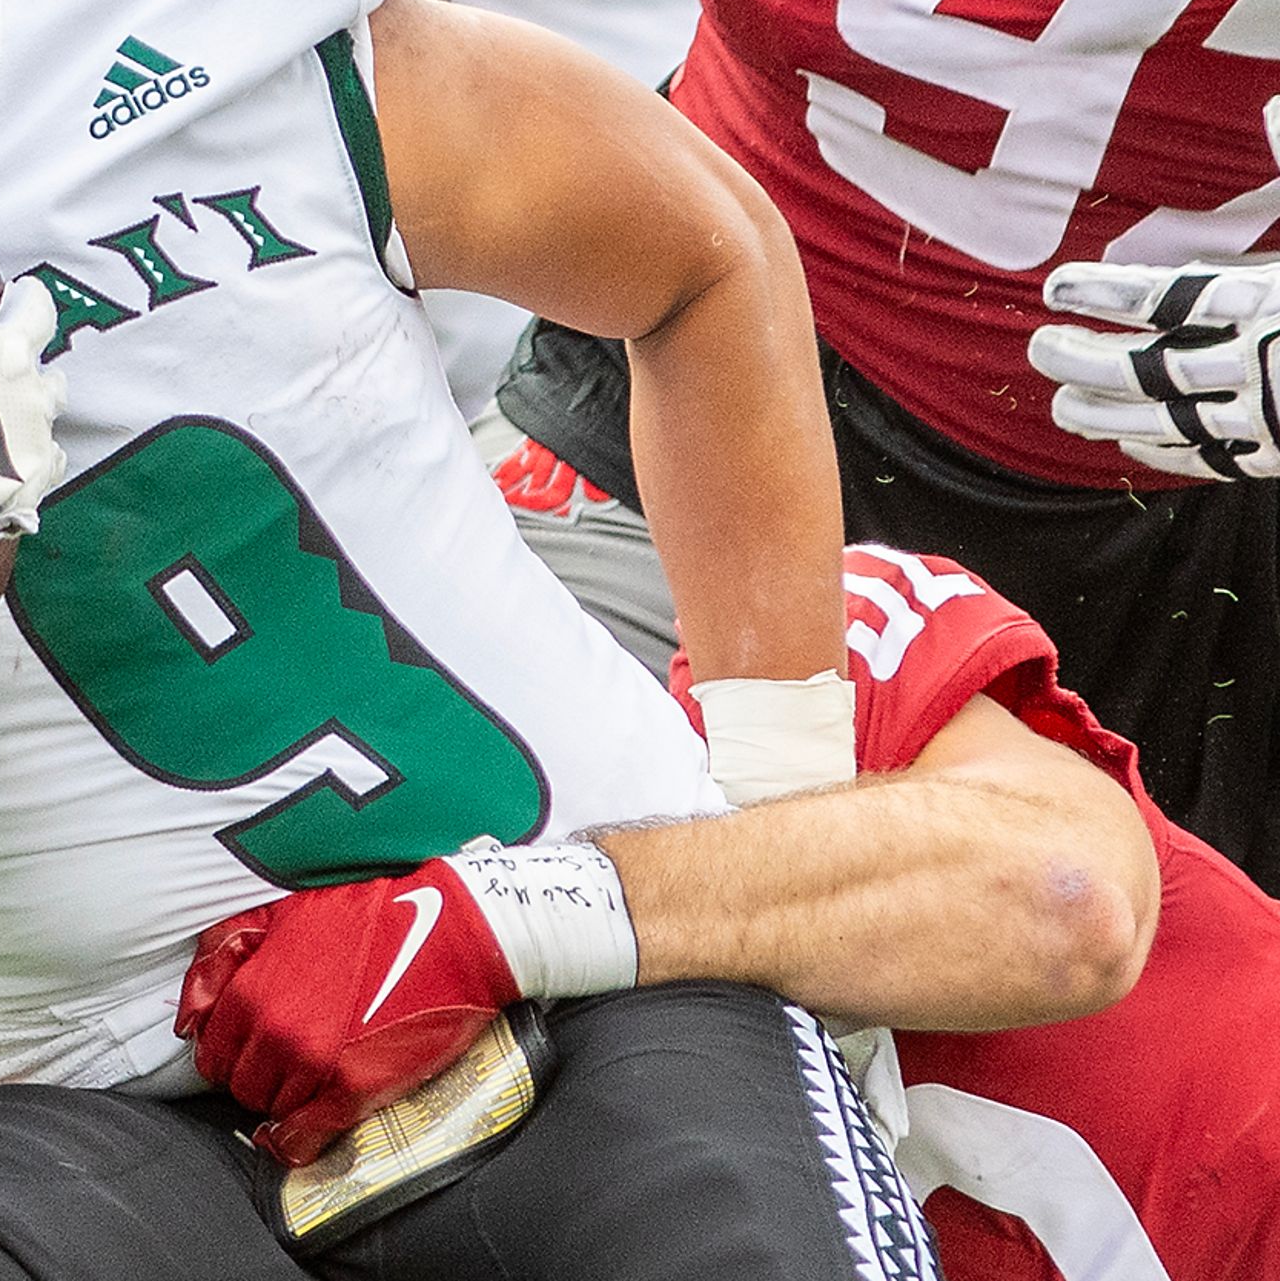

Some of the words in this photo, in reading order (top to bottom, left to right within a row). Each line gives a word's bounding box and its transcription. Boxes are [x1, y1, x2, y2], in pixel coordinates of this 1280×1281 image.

[89, 66, 211, 140] adidas
[12, 183, 318, 365] AI'I
[5, 415, 552, 891] 9
